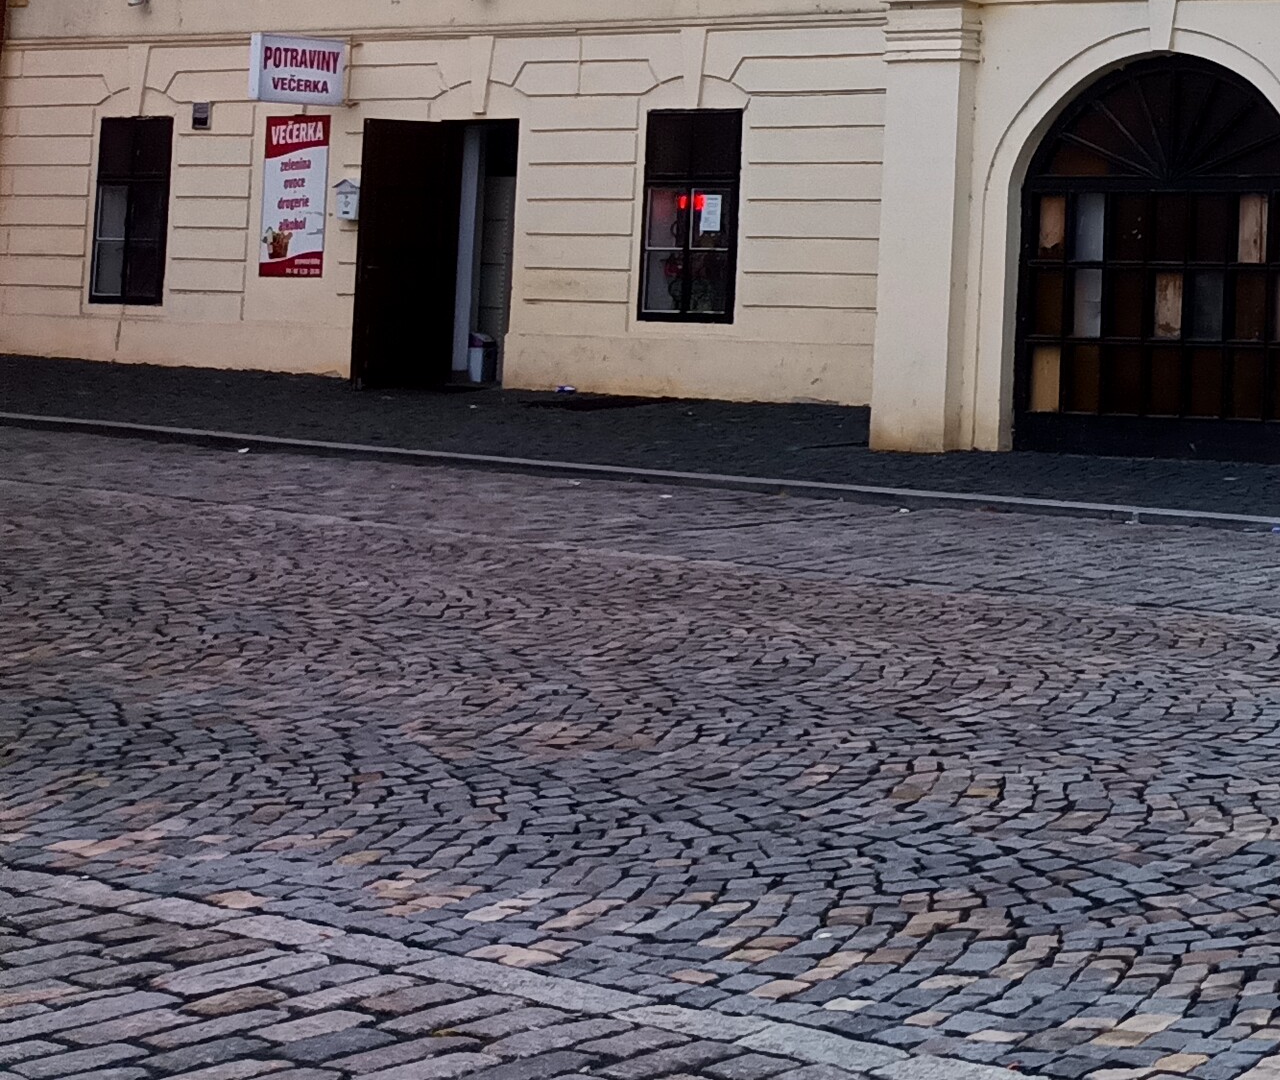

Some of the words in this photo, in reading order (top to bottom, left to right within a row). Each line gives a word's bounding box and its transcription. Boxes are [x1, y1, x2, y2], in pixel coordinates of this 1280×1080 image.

[264, 46, 340, 74] POTRAVINY
[272, 74, 329, 94] VEČERKA
[271, 121, 323, 145] VEČERKA
[280, 157, 311, 172] zelenina
[284, 177, 305, 189] ovoce
[277, 195, 309, 210] drogerie
[278, 217, 307, 231] alkohol
